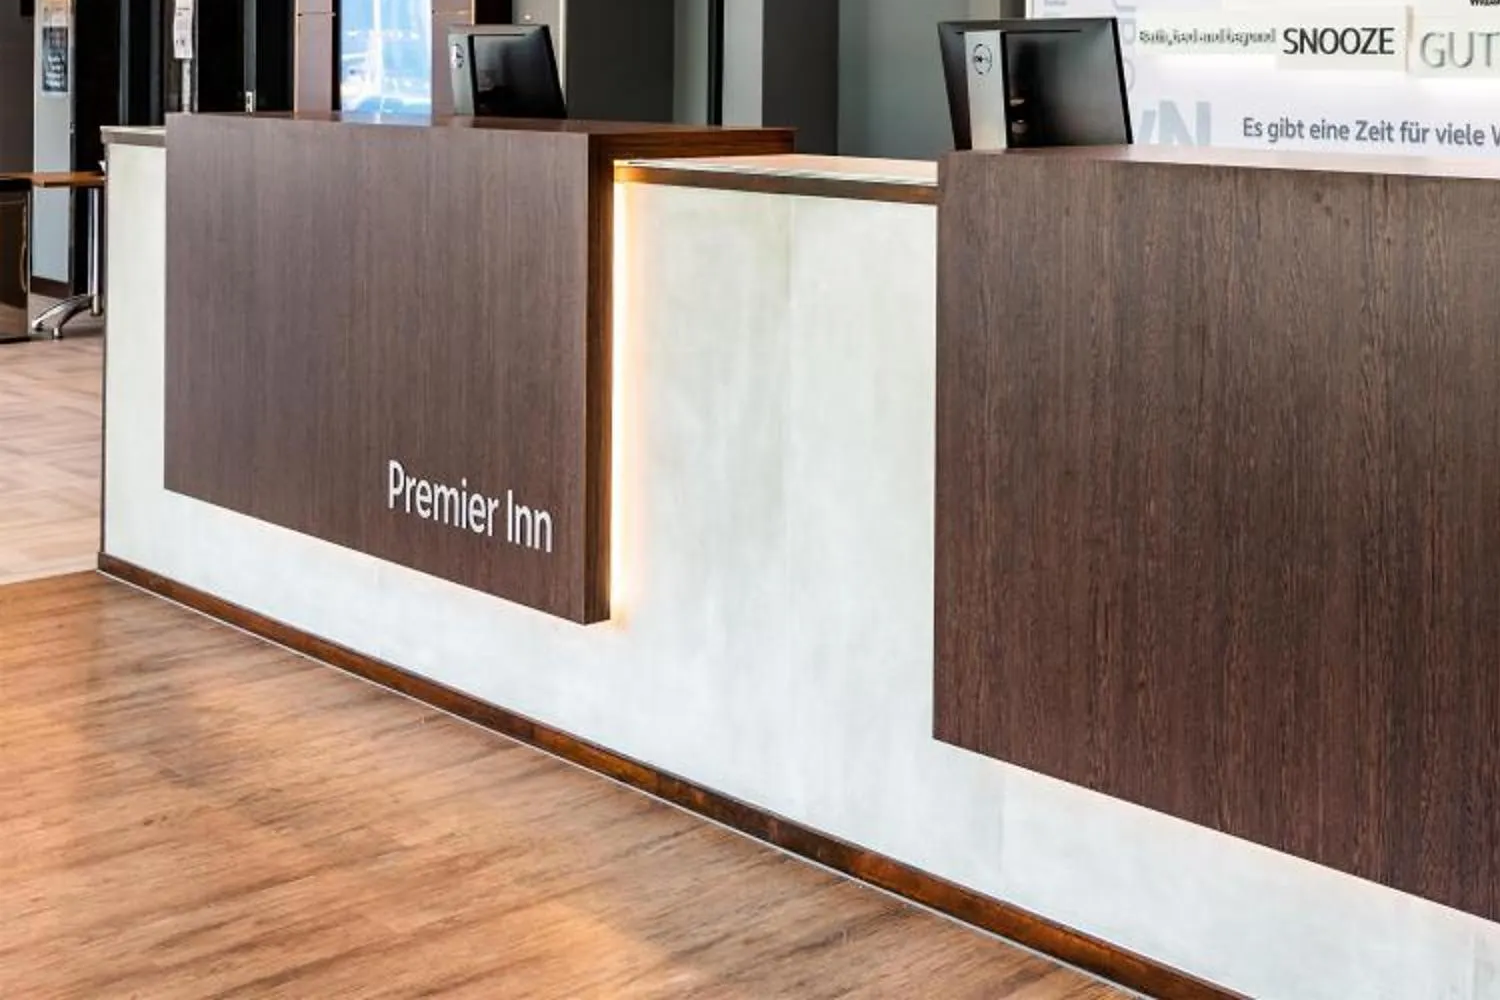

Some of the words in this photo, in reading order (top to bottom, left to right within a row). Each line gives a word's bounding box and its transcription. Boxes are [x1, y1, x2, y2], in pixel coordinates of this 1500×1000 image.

[1283, 27, 1394, 55] SNOOZE
[1243, 118, 1263, 137] Es
[1268, 117, 1305, 143] gibt
[1310, 120, 1349, 141] eine
[1355, 119, 1393, 143] Zeit
[1401, 121, 1429, 143] für
[1435, 123, 1485, 148] viele
[389, 460, 499, 536] Premier
[508, 489, 552, 552] Inn
